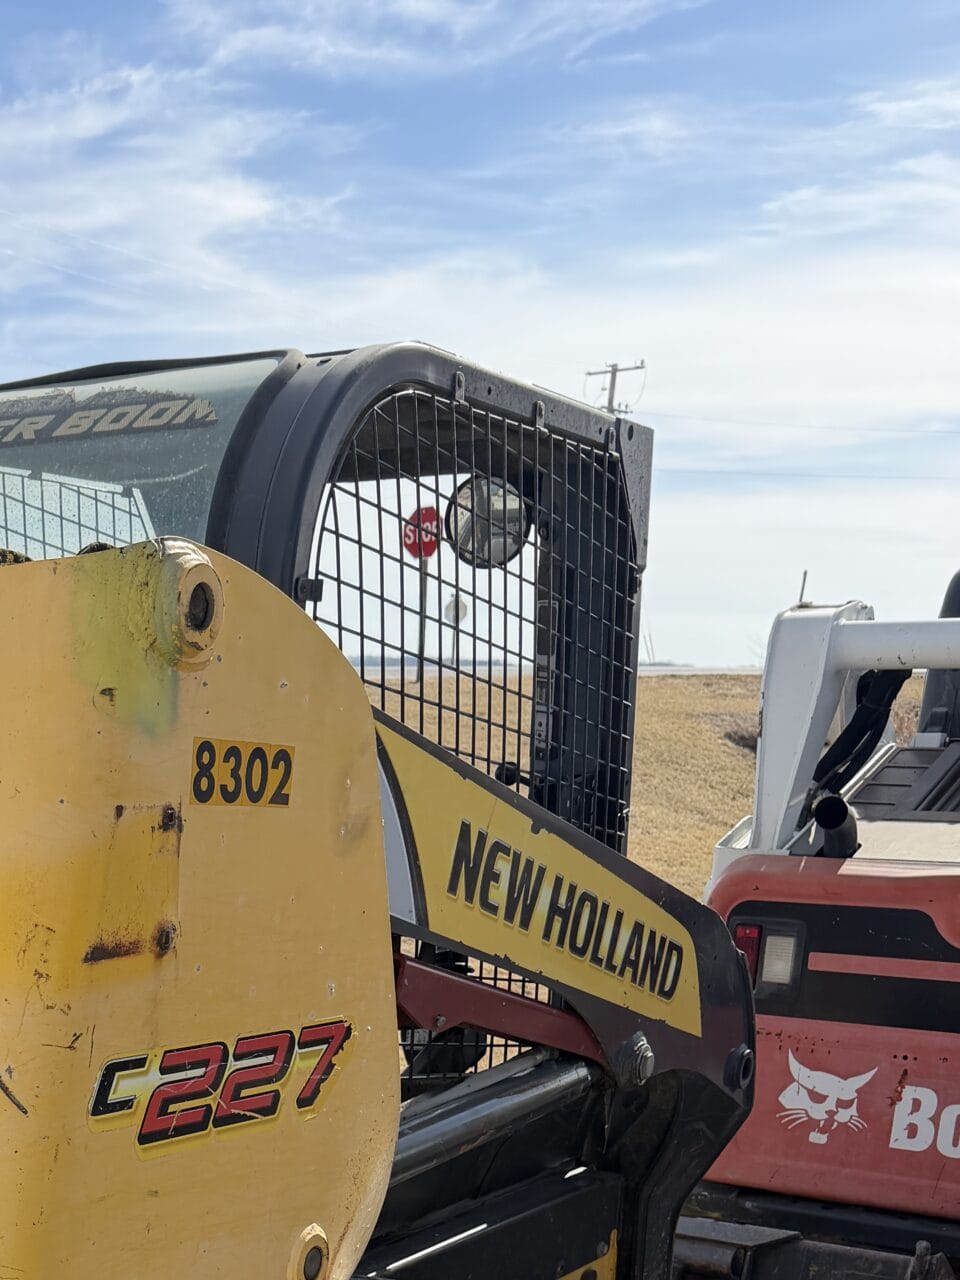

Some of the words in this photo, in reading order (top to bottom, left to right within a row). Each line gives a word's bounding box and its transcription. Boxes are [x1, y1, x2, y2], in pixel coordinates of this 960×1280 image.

[53, 399, 220, 438] BOOM
[193, 740, 292, 805] 8302
[447, 818, 546, 932] NEW
[542, 873, 683, 1001] HOLLAND
[90, 1020, 352, 1145] C227
